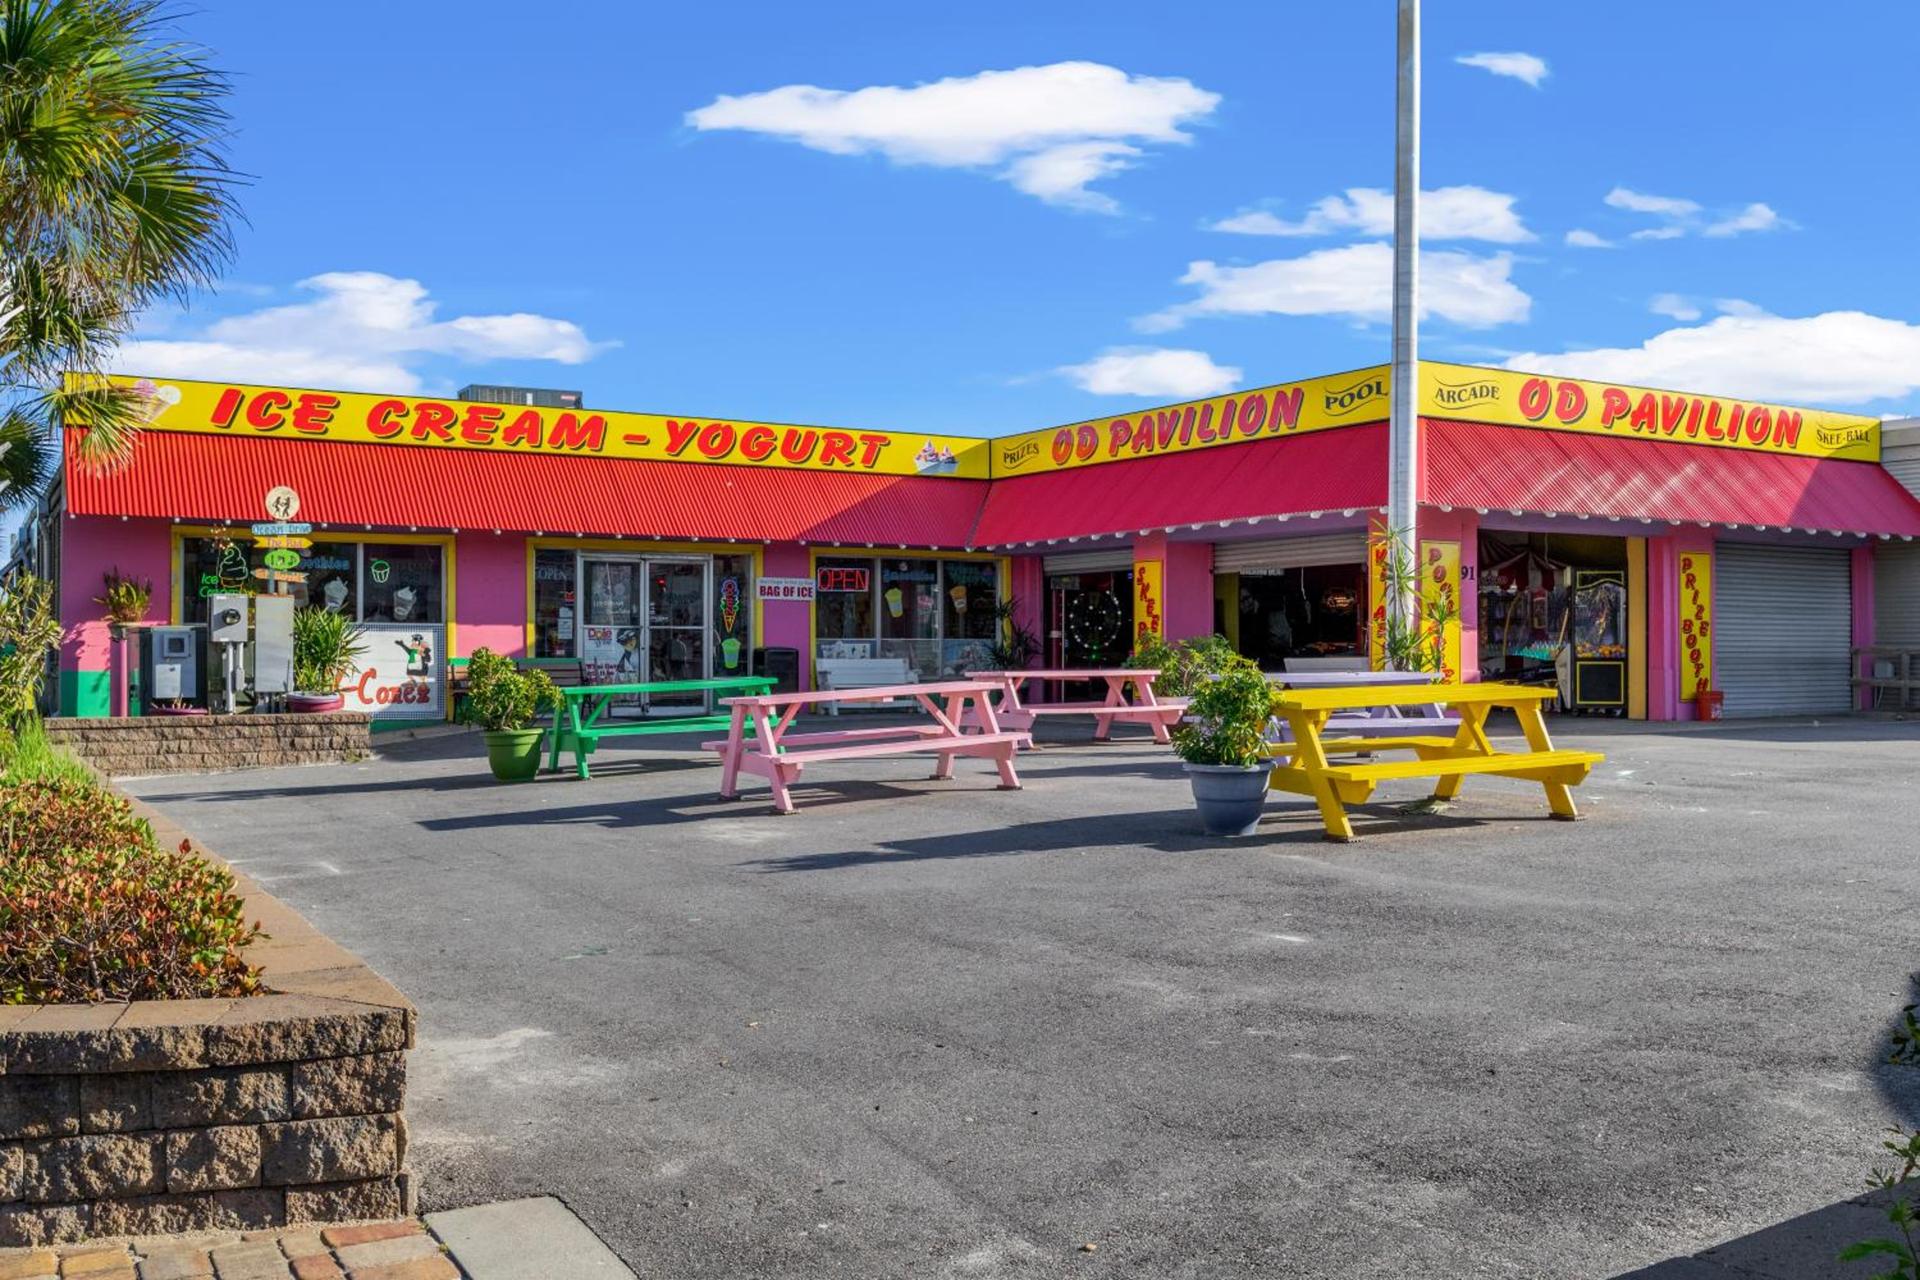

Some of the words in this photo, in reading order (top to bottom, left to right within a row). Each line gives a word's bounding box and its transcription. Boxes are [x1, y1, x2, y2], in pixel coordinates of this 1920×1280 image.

[1324, 378, 1389, 412] POOL
[1434, 384, 1500, 405] ARCADE
[1518, 376, 1589, 424] OD
[1600, 386, 1803, 449] PAVILION
[210, 388, 341, 436] ICE
[366, 399, 606, 451] CREAM
[664, 419, 890, 469] YOGURT
[1051, 425, 1098, 466] OD
[1108, 387, 1305, 458] PAVILION
[1816, 428, 1871, 446] SKEE-BALL
[1003, 441, 1040, 466] PRIZES
[202, 574, 219, 584] Ice
[819, 569, 866, 590] OPEN
[1461, 566, 1475, 580] 91
[759, 585, 780, 597] BAG
[783, 586, 796, 597] OF
[797, 586, 813, 598] ICE
[1137, 566, 1159, 633] SKEE
[1682, 557, 1710, 637] PRIZE
[588, 627, 612, 640] Dole
[1682, 619, 1709, 694] BOOTH
